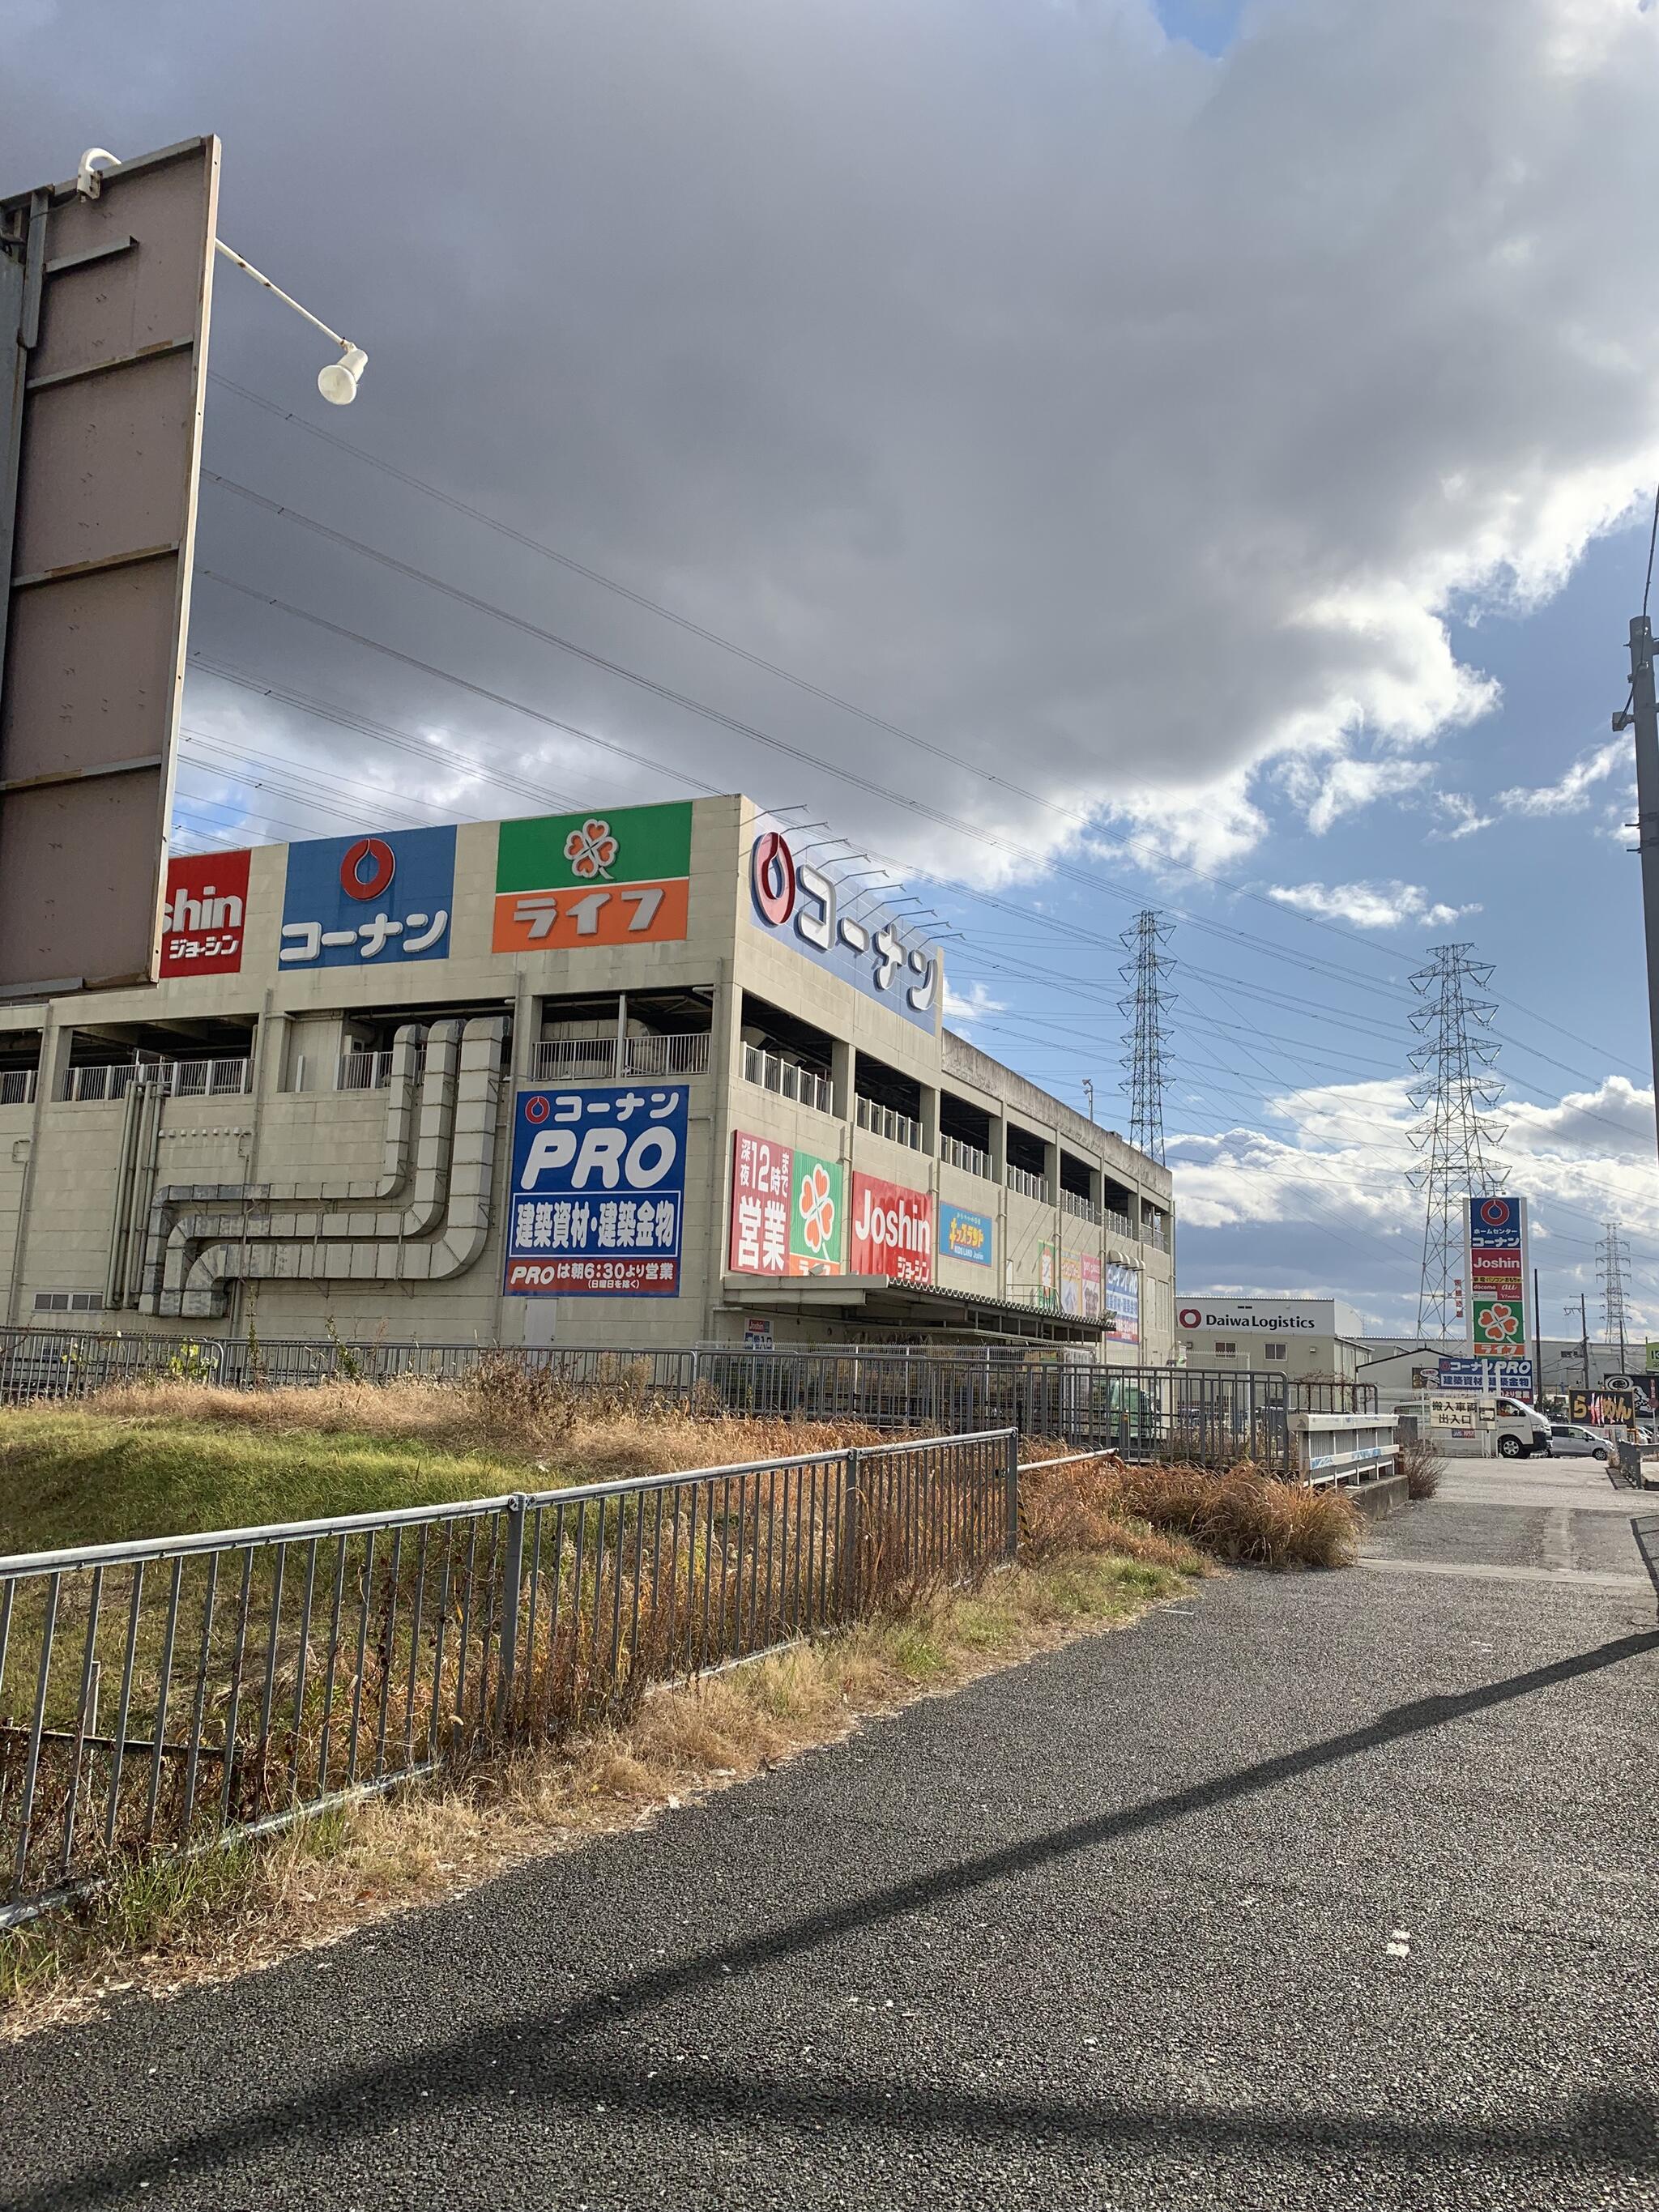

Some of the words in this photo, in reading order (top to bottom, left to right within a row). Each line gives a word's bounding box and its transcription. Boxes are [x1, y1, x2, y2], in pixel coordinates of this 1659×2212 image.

[514, 888, 664, 939] ライフ
[168, 934, 239, 959] ジョーシン
[280, 910, 449, 961] コーナン
[794, 863, 937, 1011] コーナン
[554, 1093, 679, 1122] コーナン
[521, 1126, 676, 1190] PRO
[515, 1200, 675, 1249] 建築資材・建築金物
[738, 1195, 787, 1271] 営業
[855, 1189, 931, 1255] Joshin
[1472, 1237, 1520, 1247] コーナン
[897, 1256, 930, 1283] ジョーシン
[1473, 1257, 1520, 1268] Joshin
[1206, 1314, 1249, 1327] Daiwa
[1252, 1315, 1315, 1330] Logistics
[1481, 1345, 1517, 1354] ライフ
[1443, 1376, 1529, 1386] 建築資材建築金物
[1432, 1401, 1478, 1412] 搬入車両
[1439, 1413, 1471, 1424] 出入口
[1573, 1395, 1631, 1420] らめん
